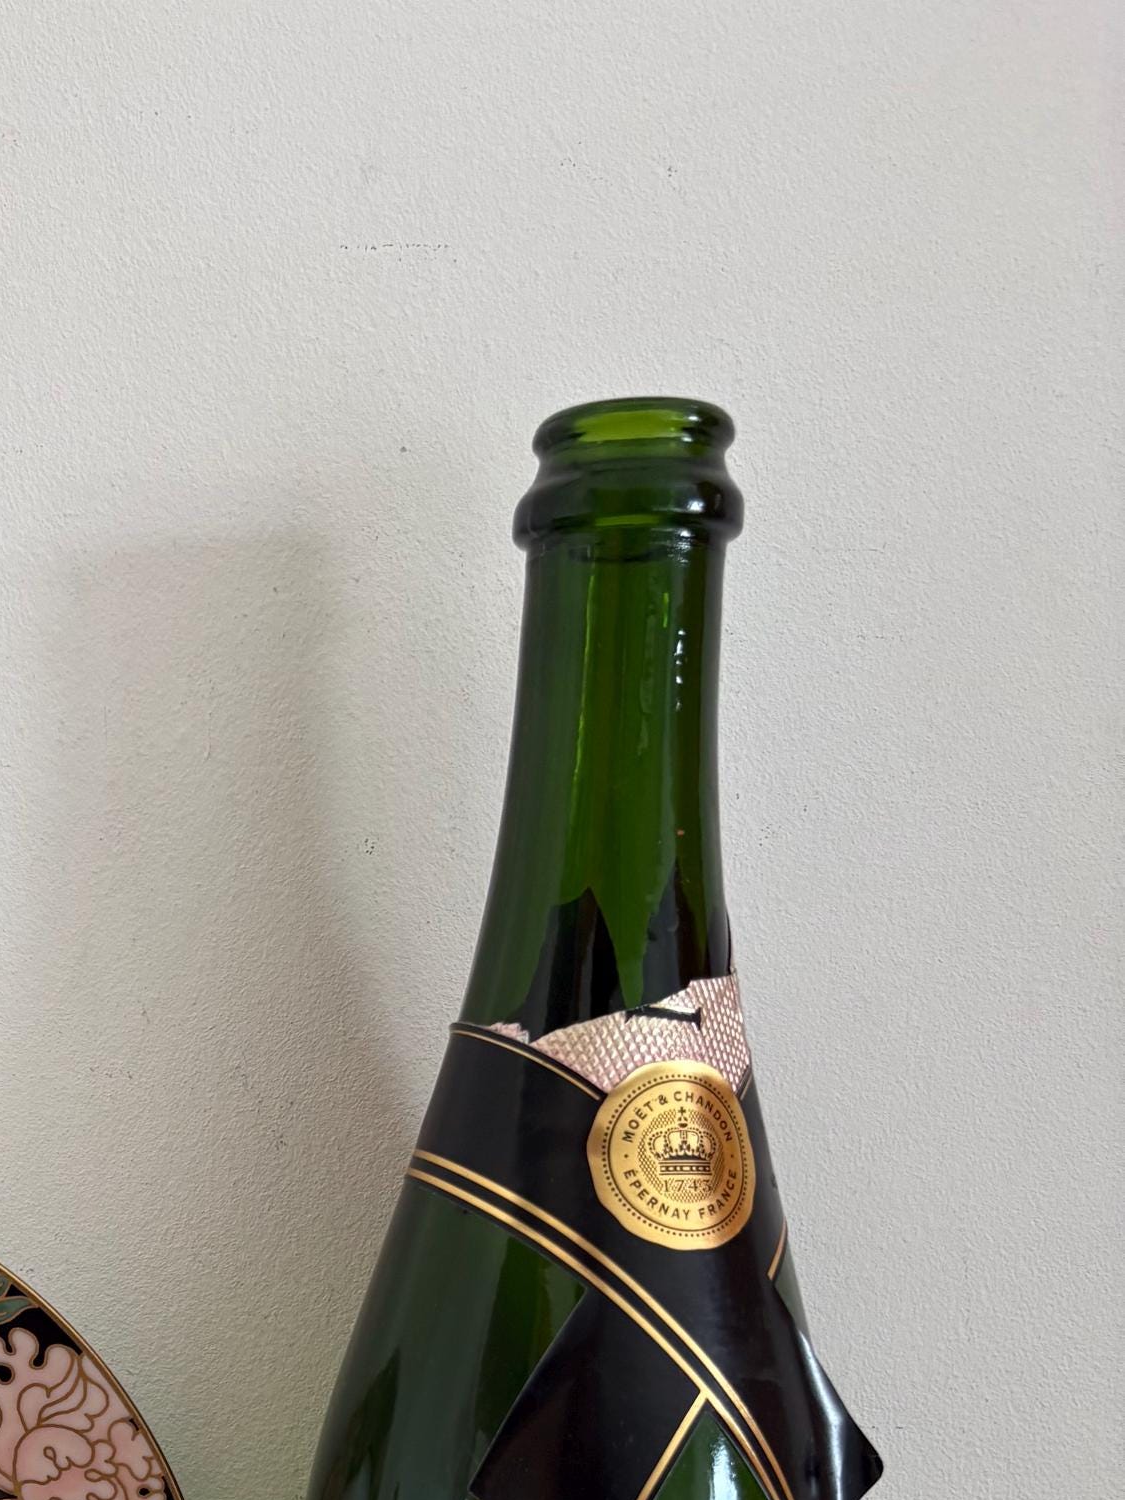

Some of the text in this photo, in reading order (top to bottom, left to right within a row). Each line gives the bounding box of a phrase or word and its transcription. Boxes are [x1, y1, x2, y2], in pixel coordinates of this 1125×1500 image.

[622, 1091, 733, 1143] MOËT & CHANDON
[623, 1168, 738, 1220] ÉPERNAY FRANCE
[662, 1179, 713, 1194] 1743
